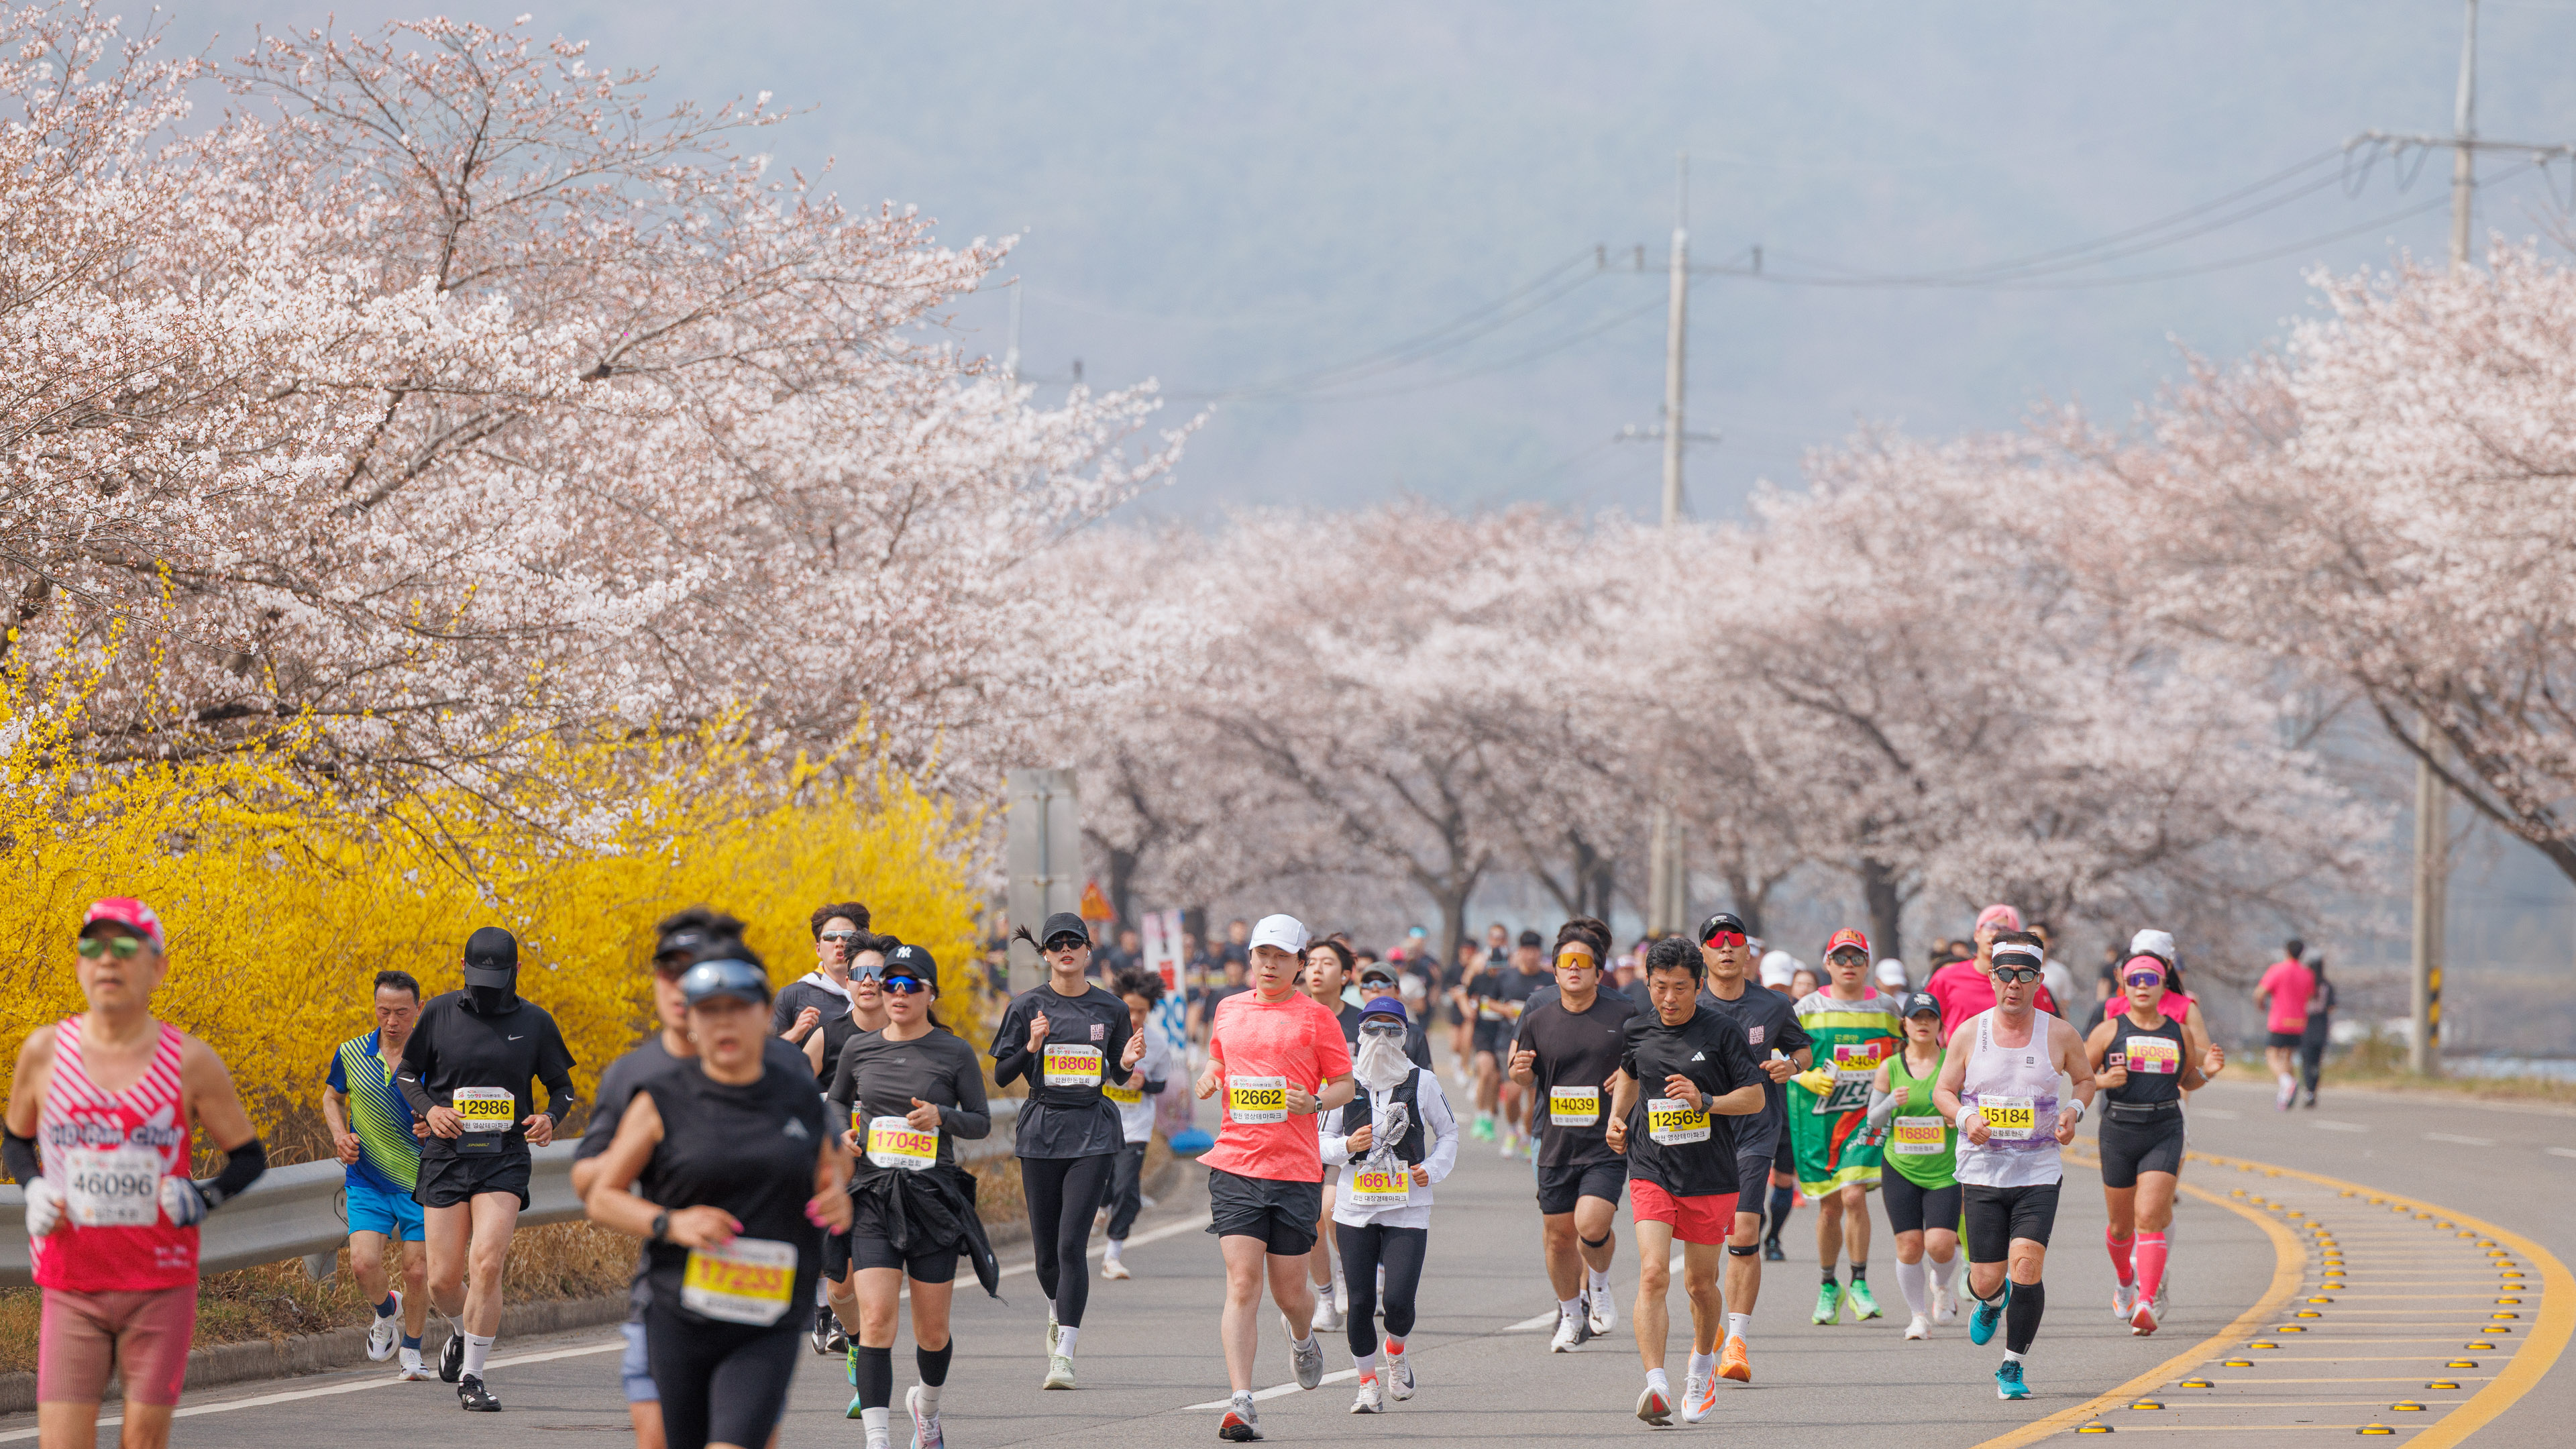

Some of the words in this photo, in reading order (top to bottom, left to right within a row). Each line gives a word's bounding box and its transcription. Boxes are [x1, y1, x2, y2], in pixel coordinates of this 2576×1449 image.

[1090, 1023, 1104, 1032] RUN
[1750, 1025, 1764, 1035] RUN
[1750, 1035, 1764, 1045] RACE
[2133, 1046, 2174, 1059] 16089
[1049, 1057, 1097, 1071] 16806
[1234, 1089, 1282, 1105] 12662
[1554, 1097, 1595, 1110] 14039
[459, 1100, 510, 1115] 12986
[1244, 1112, 1282, 1120] 영상테마파크
[1654, 1110, 1704, 1127] 12569
[1984, 1108, 2030, 1123] 15184
[1667, 1131, 1705, 1141] 영상테마파크
[1898, 1127, 1939, 1140] 16880
[876, 1131, 932, 1152] 17045
[73, 1173, 154, 1196] 46096
[1359, 1173, 1404, 1188] 16614
